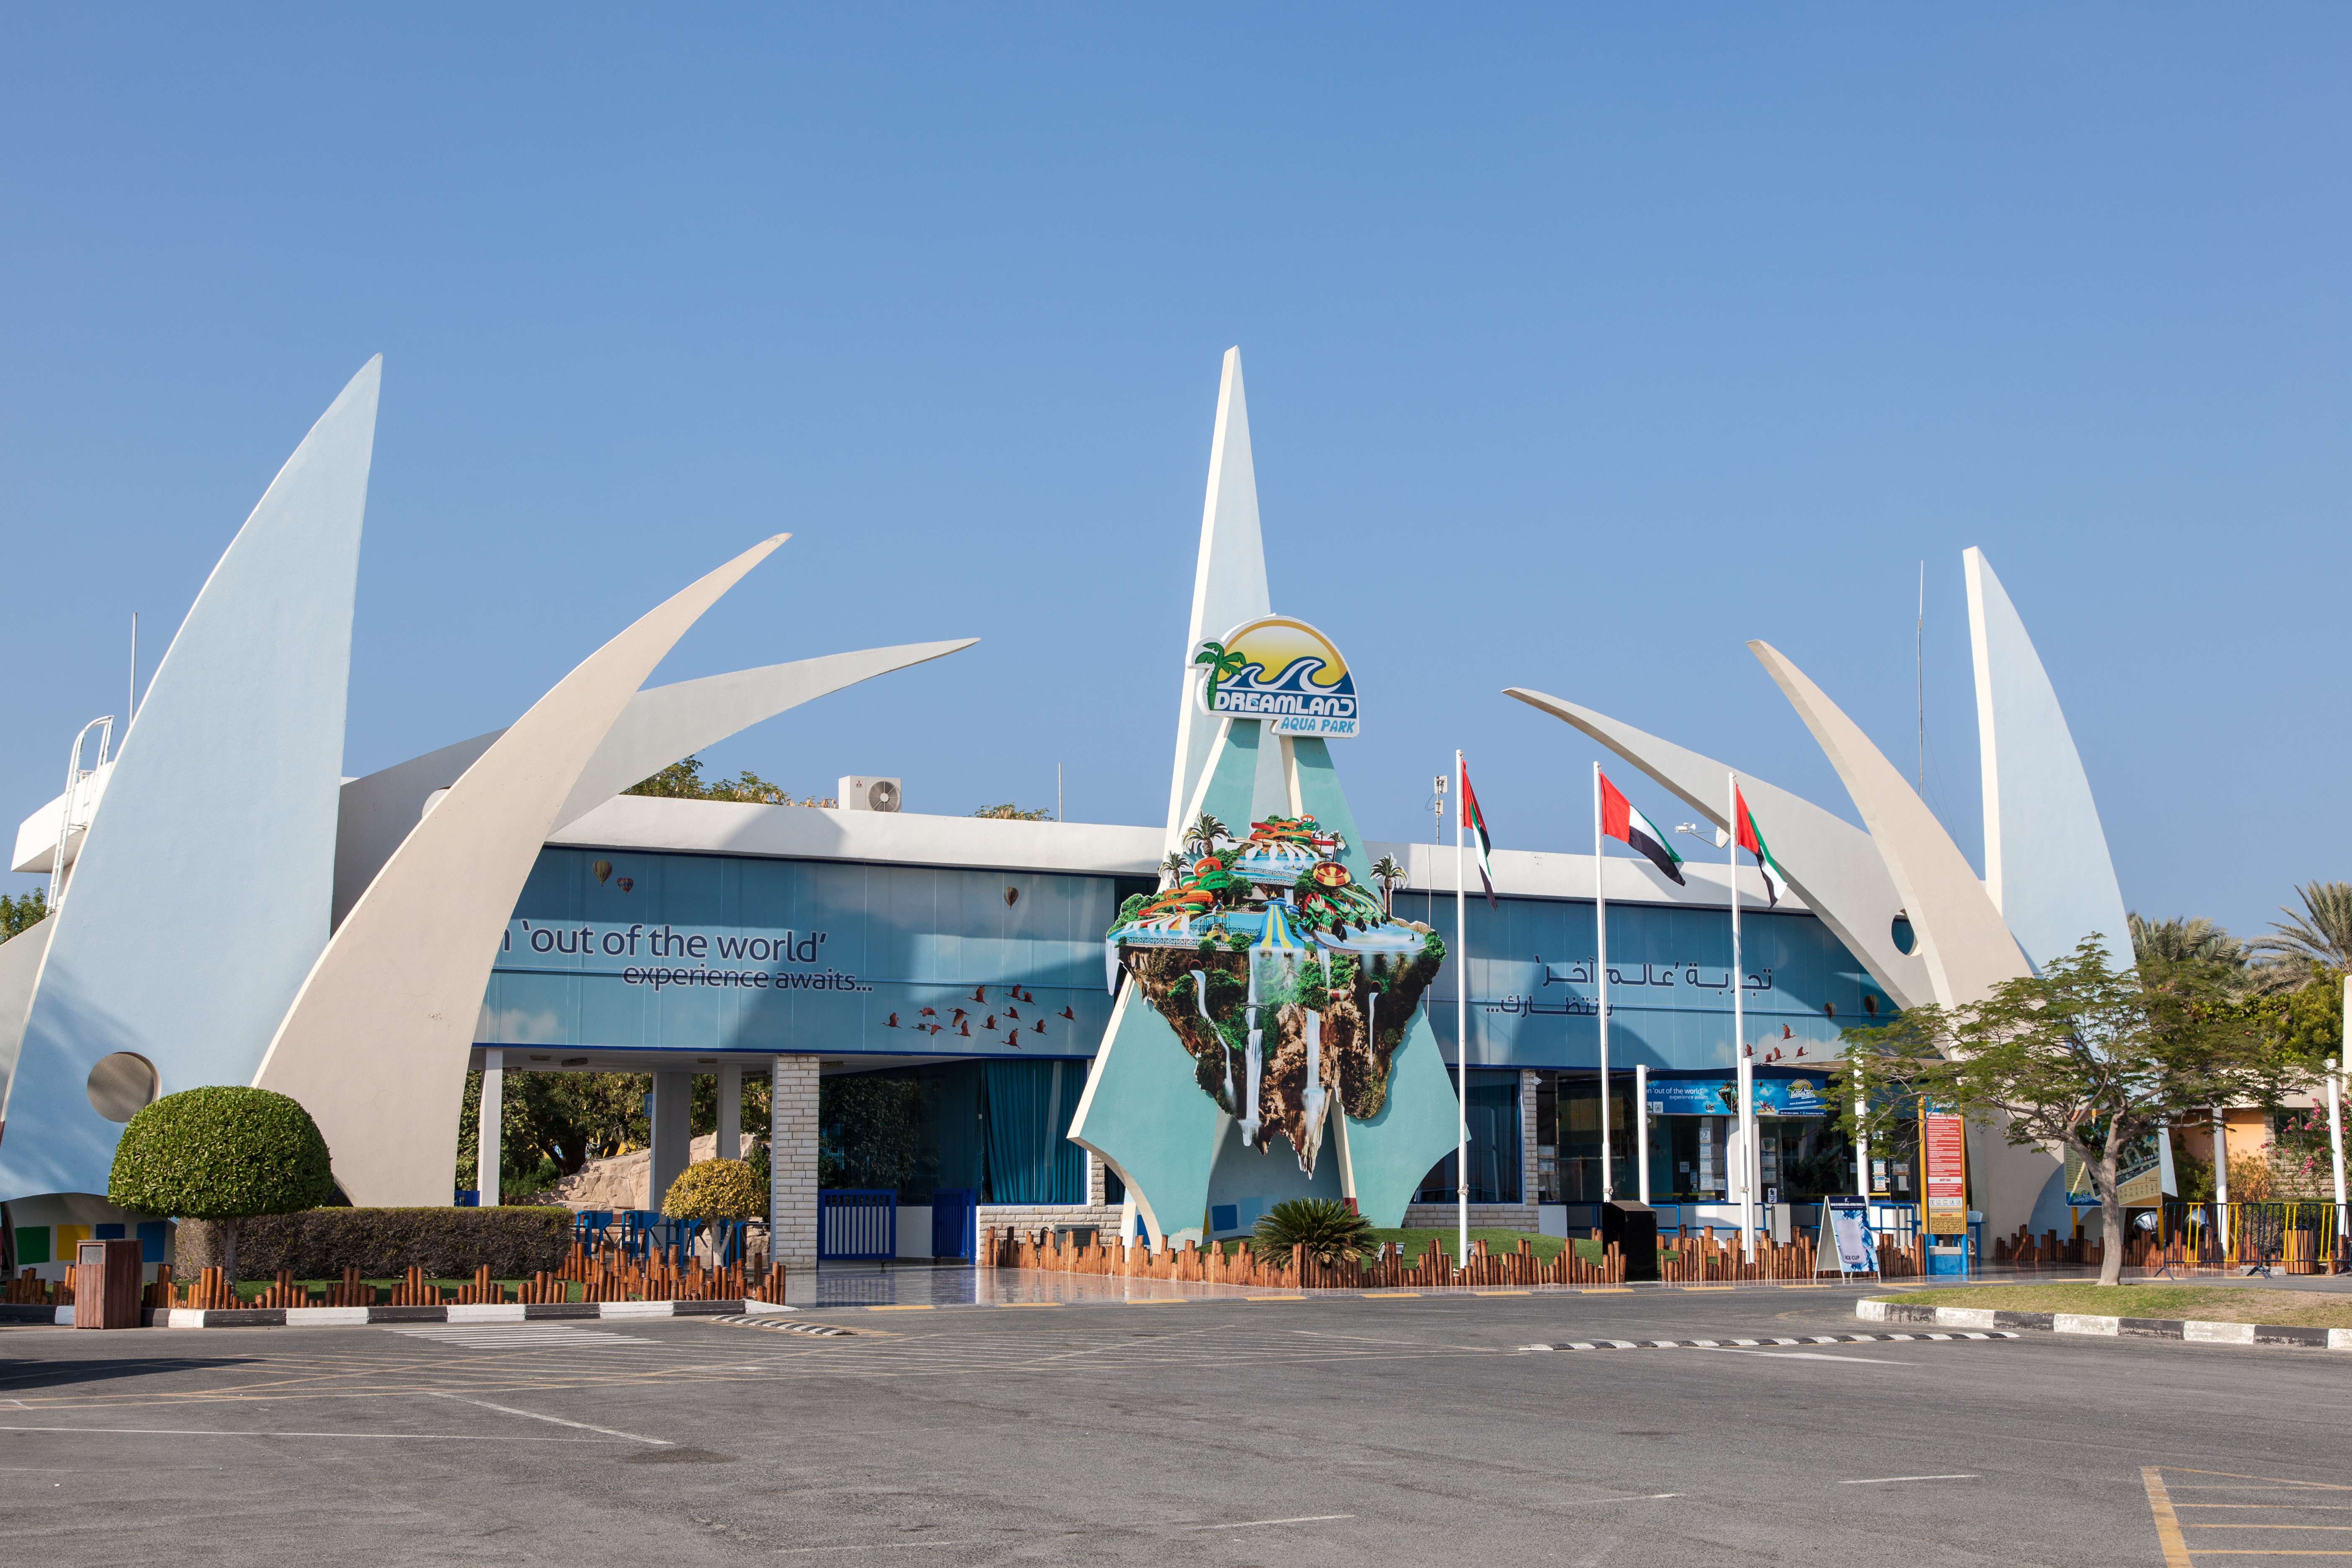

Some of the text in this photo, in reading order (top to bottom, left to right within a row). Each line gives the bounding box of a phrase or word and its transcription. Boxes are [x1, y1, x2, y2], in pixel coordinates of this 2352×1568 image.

[1214, 691, 1354, 717] DREAMLAND
[1280, 717, 1355, 733] AQUA PARK
[602, 924, 642, 955] of
[648, 925, 708, 958] the
[623, 963, 873, 991] experience awaits...
